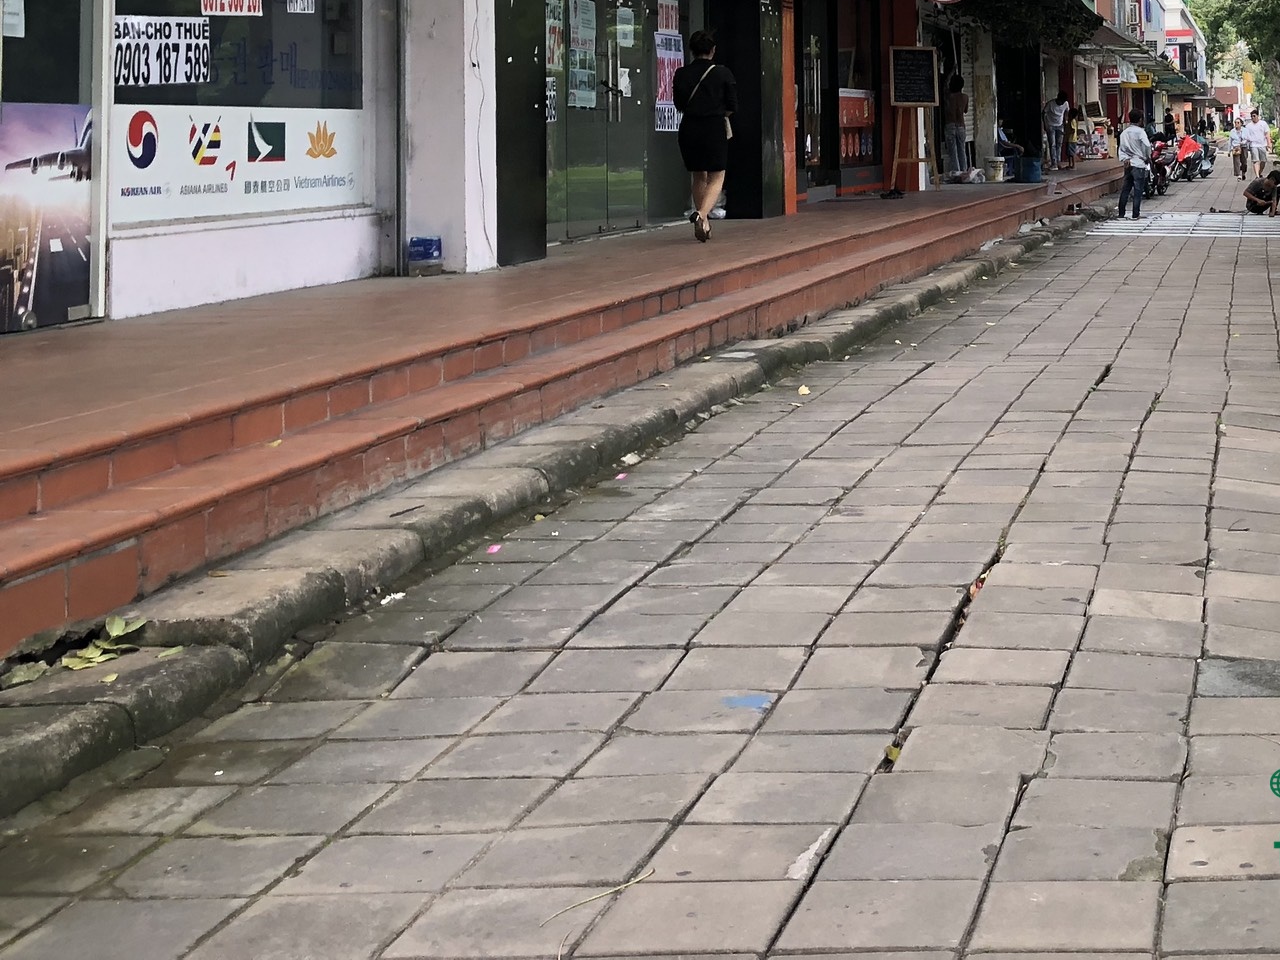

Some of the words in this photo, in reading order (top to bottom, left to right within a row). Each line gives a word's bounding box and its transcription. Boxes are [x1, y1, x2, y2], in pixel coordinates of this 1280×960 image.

[114, 18, 172, 40] BÁN-CHO
[175, 19, 210, 40] THUÊ
[114, 42, 151, 85] 0903
[156, 42, 180, 84] 187
[184, 42, 210, 83] 589
[120, 187, 148, 197] KOREAN
[149, 186, 162, 196] AIR
[179, 185, 201, 196] ASIANA
